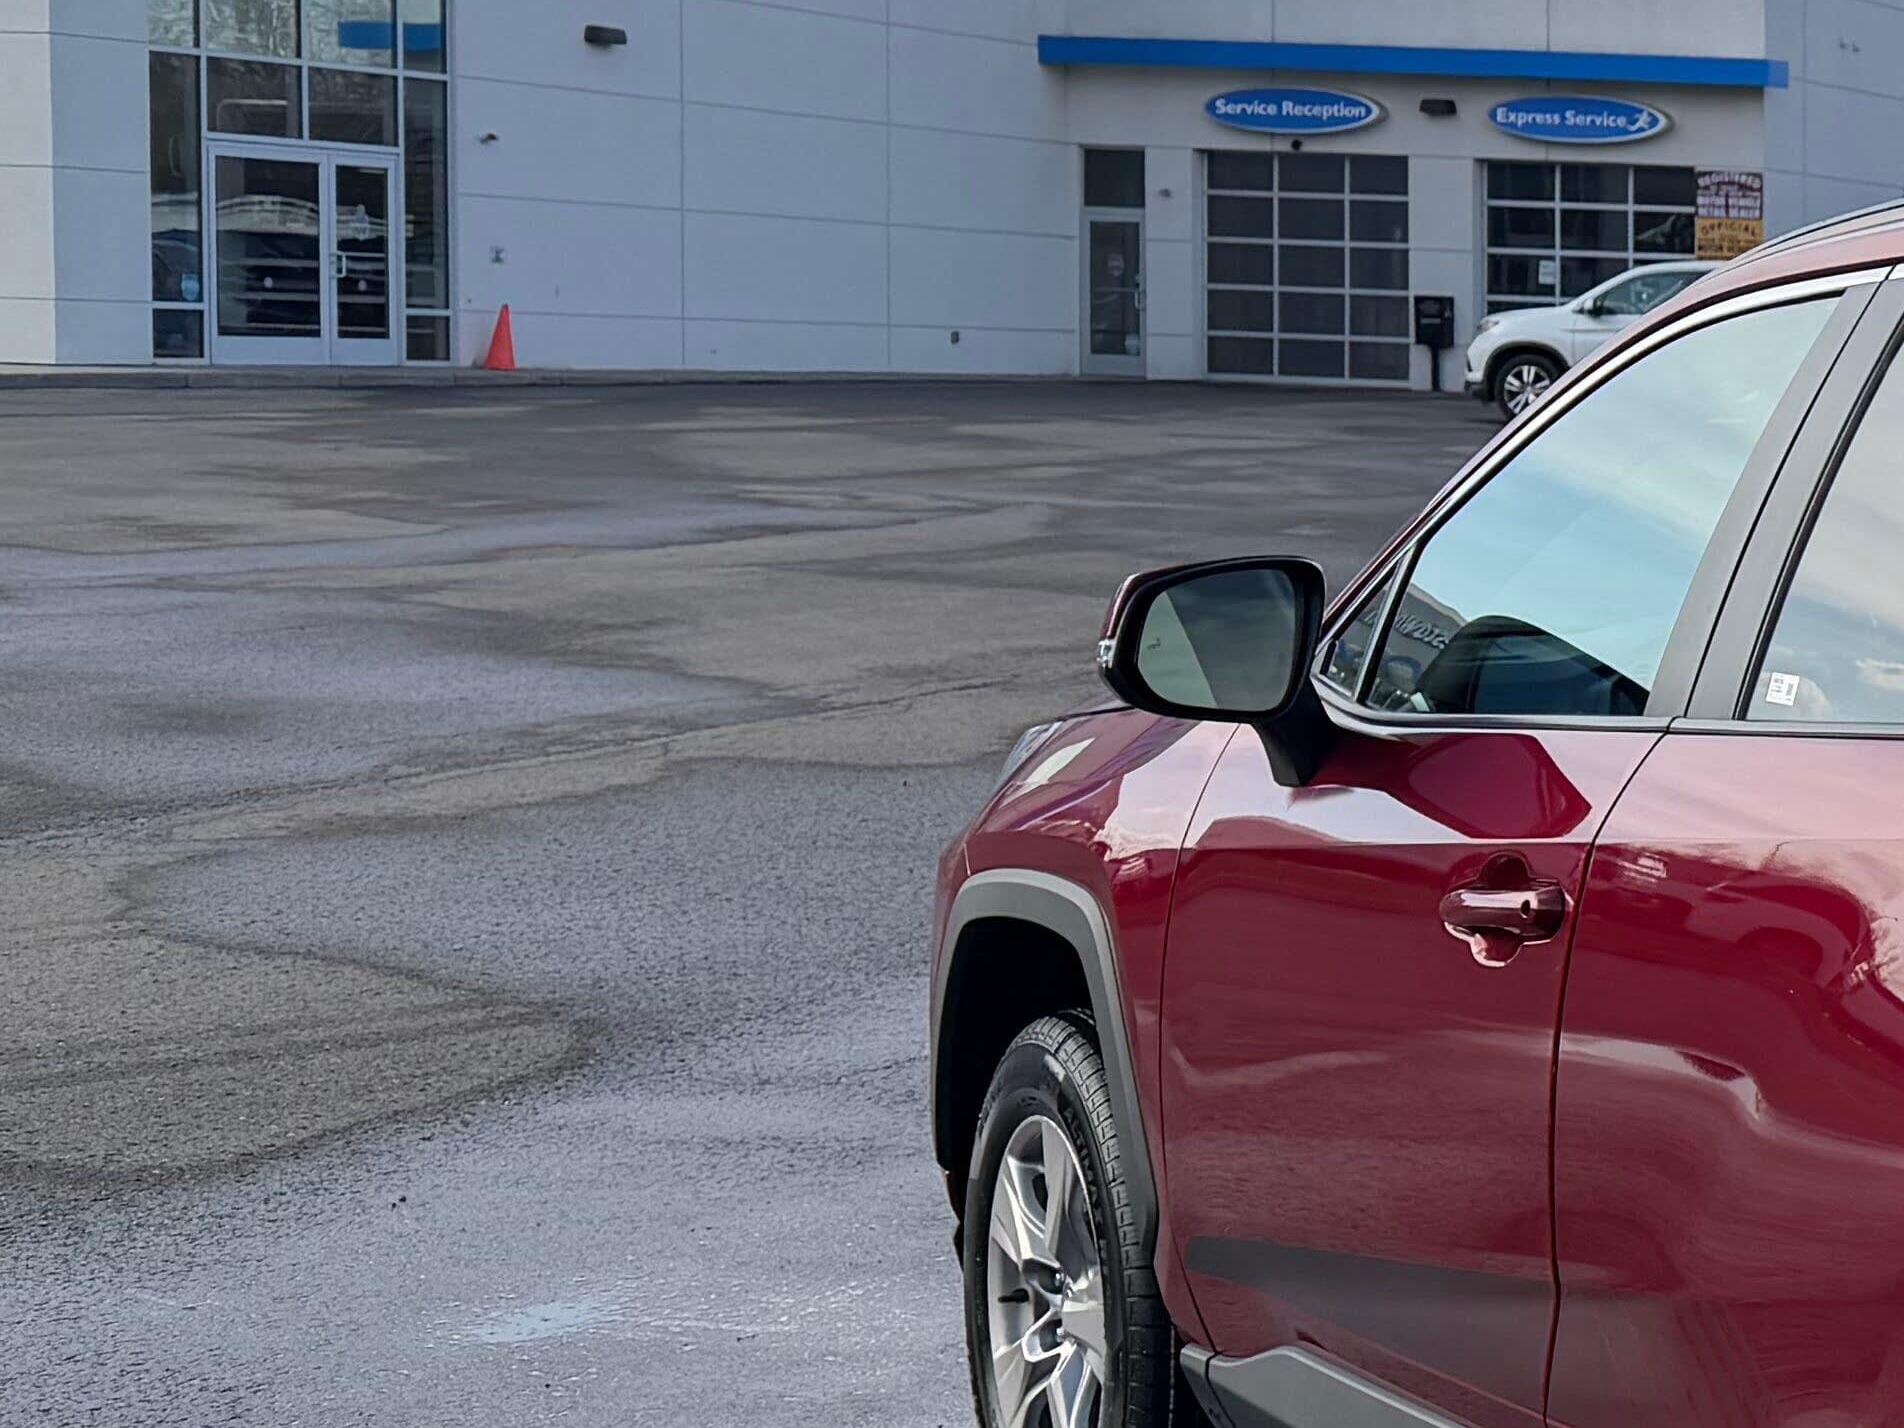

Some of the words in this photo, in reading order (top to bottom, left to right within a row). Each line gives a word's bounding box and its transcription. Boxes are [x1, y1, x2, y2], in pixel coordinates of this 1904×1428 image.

[1215, 98, 1277, 115] Service
[1282, 100, 1366, 121] Reception
[1496, 107, 1561, 128] Express
[1564, 109, 1627, 128] Service
[1700, 222, 1756, 236] OFFICIAL
